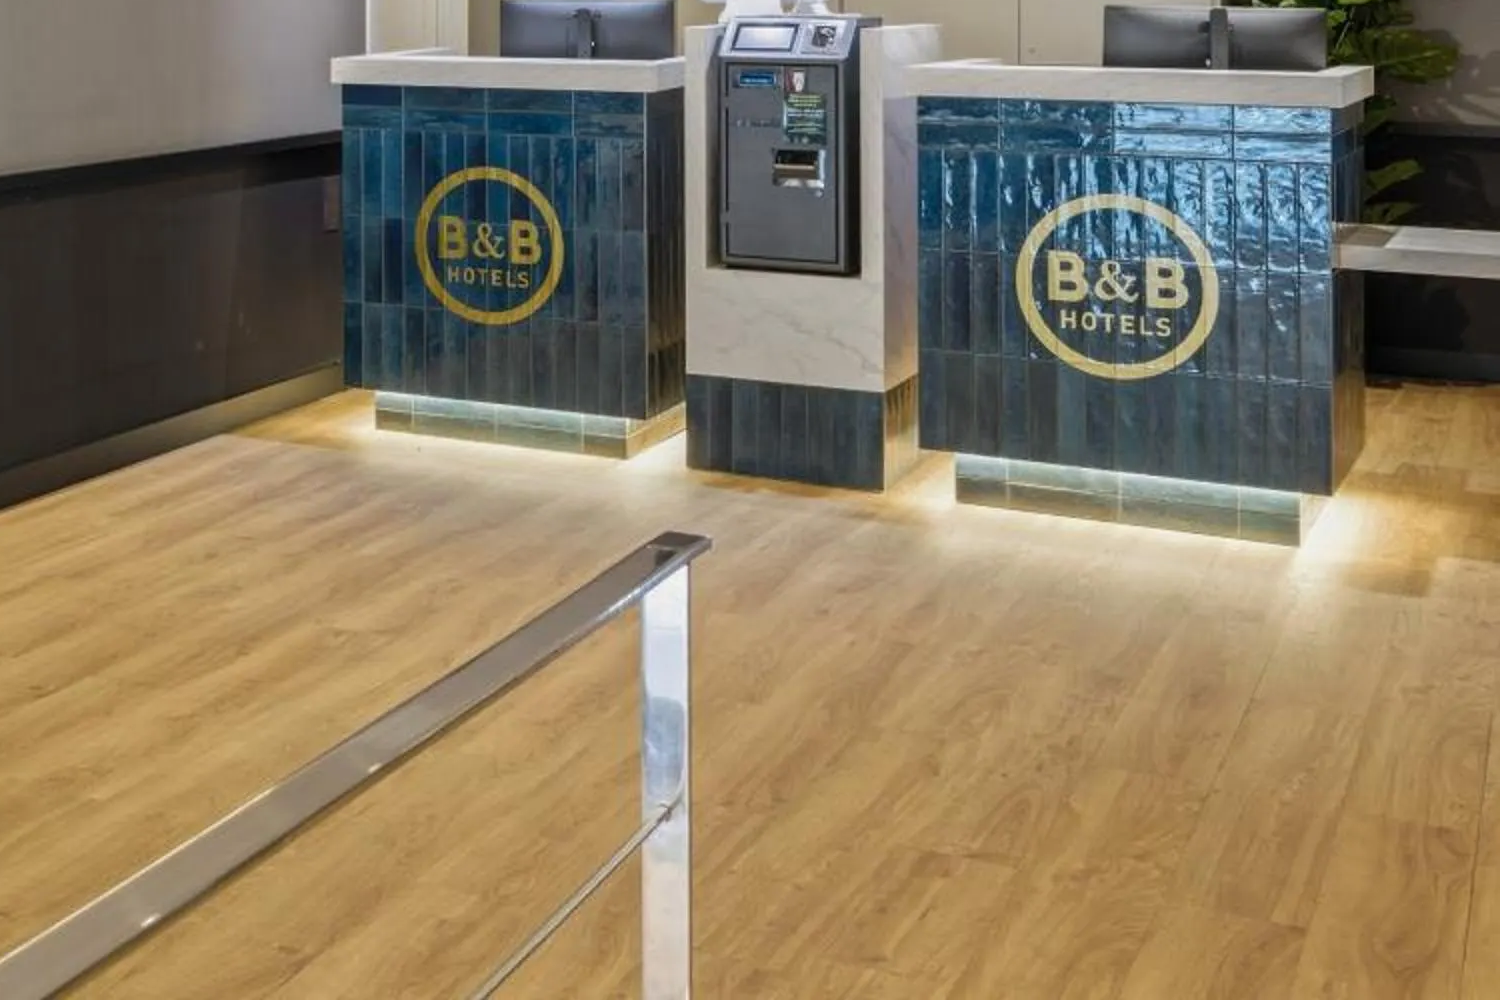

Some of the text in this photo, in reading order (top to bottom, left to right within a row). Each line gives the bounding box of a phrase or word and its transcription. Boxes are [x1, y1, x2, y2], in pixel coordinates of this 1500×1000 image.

[437, 214, 542, 265] B&B
[448, 266, 530, 289] HOTELS
[1047, 249, 1189, 310] B&B
[1059, 308, 1172, 337] HOTELS
